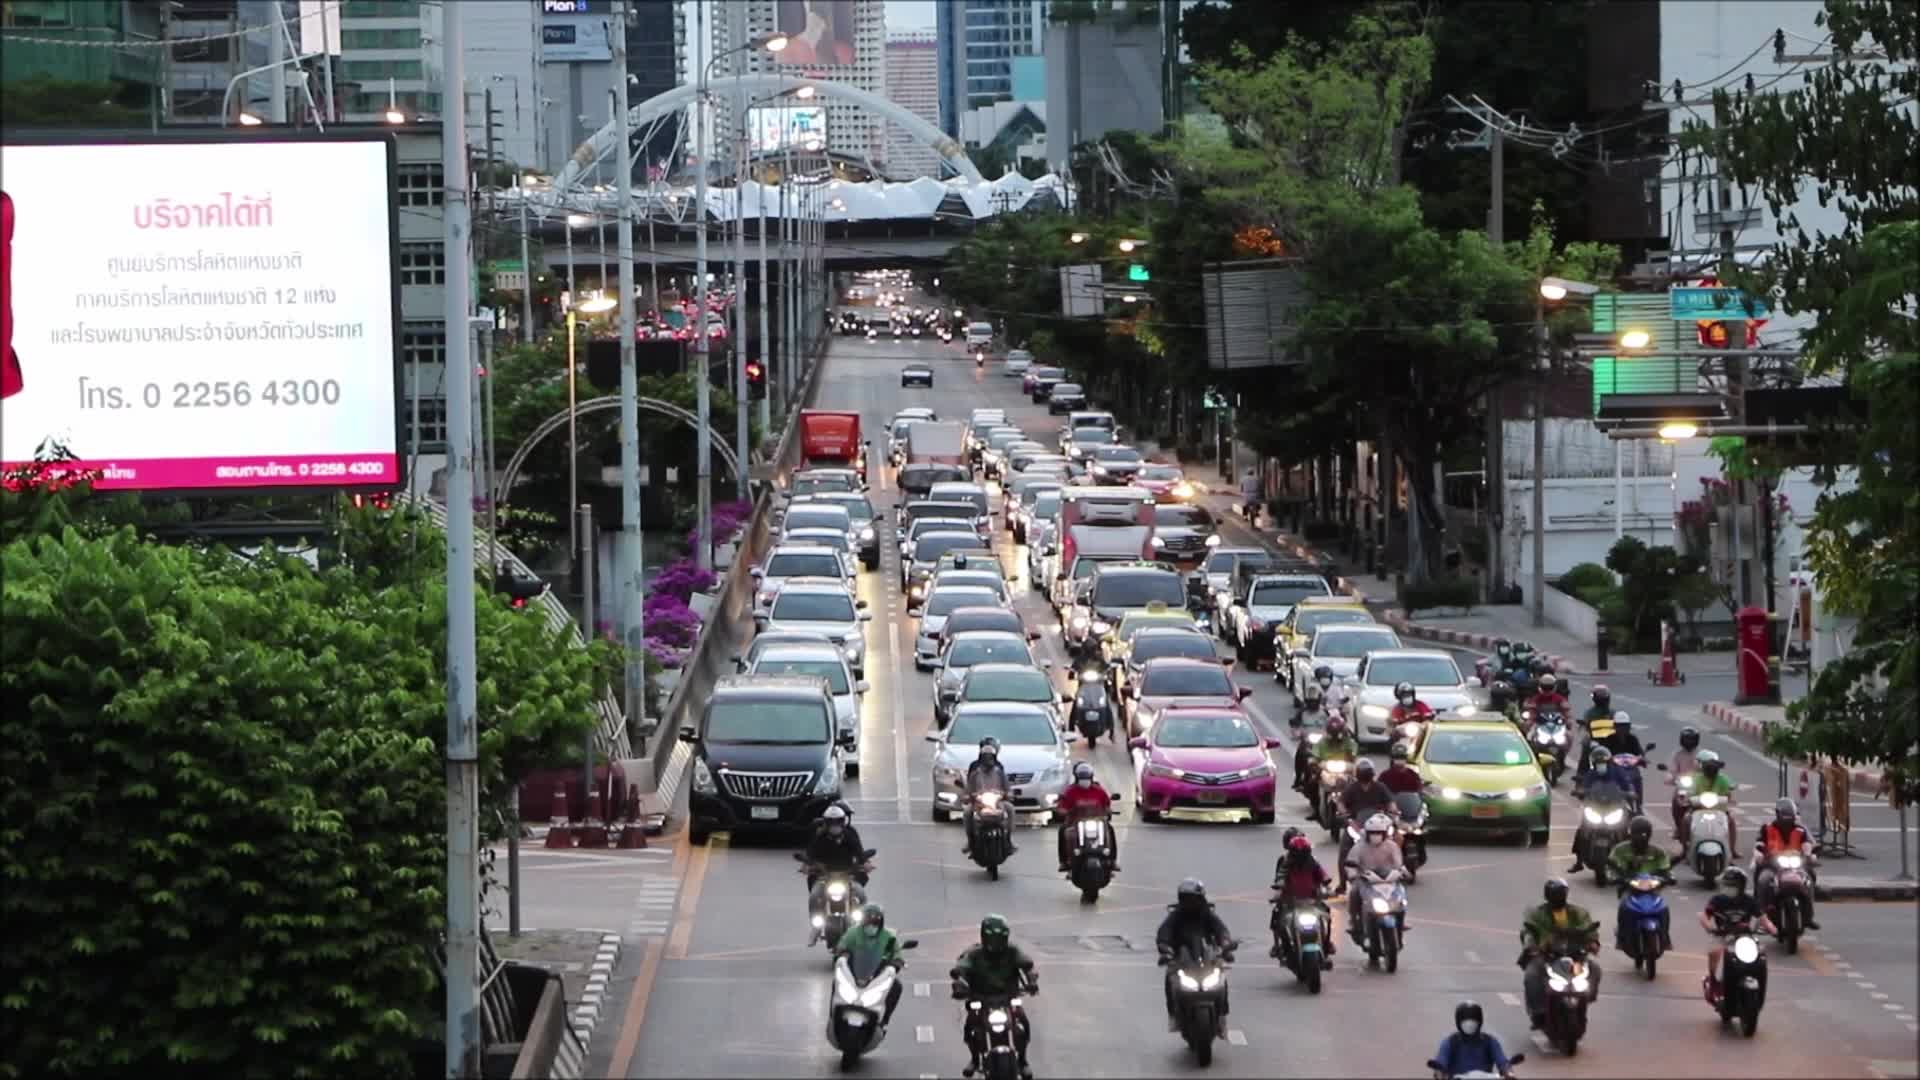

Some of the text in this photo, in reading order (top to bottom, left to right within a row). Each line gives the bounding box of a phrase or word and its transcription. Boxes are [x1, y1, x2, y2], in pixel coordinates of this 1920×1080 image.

[544, 0, 575, 12] Plan
[133, 192, 273, 229] บริจาคได้ที่
[274, 287, 297, 305] 12
[303, 284, 337, 305] แห่ง
[78, 376, 342, 410] โทร. 0 2256 4300
[298, 463, 309, 476] 0
[348, 462, 384, 475] 4300
